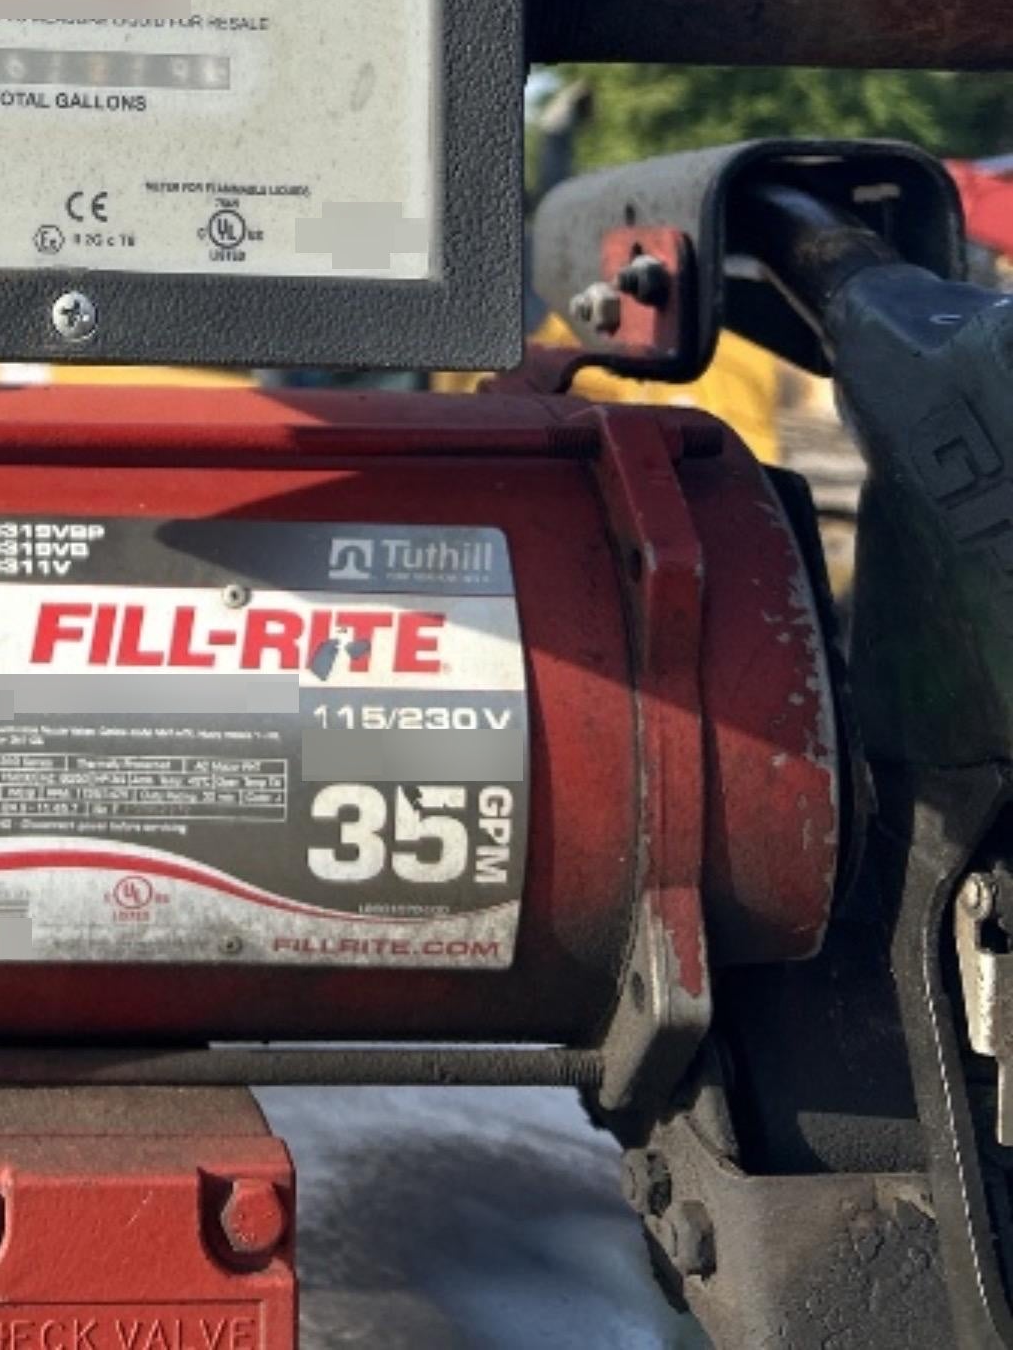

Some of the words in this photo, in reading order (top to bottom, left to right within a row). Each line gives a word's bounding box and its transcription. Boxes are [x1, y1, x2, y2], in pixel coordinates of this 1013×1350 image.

[54, 91, 148, 113] GALLONS
[64, 190, 109, 223] CE
[380, 538, 493, 572] Tuthill
[29, 602, 447, 674] FILL-RITE
[314, 704, 479, 730] 115/230
[483, 707, 511, 730] V
[307, 783, 469, 884] 35
[473, 785, 514, 884] GPM
[273, 936, 501, 956] FILLRITE.COM
[114, 1318, 255, 1350] VALVE
